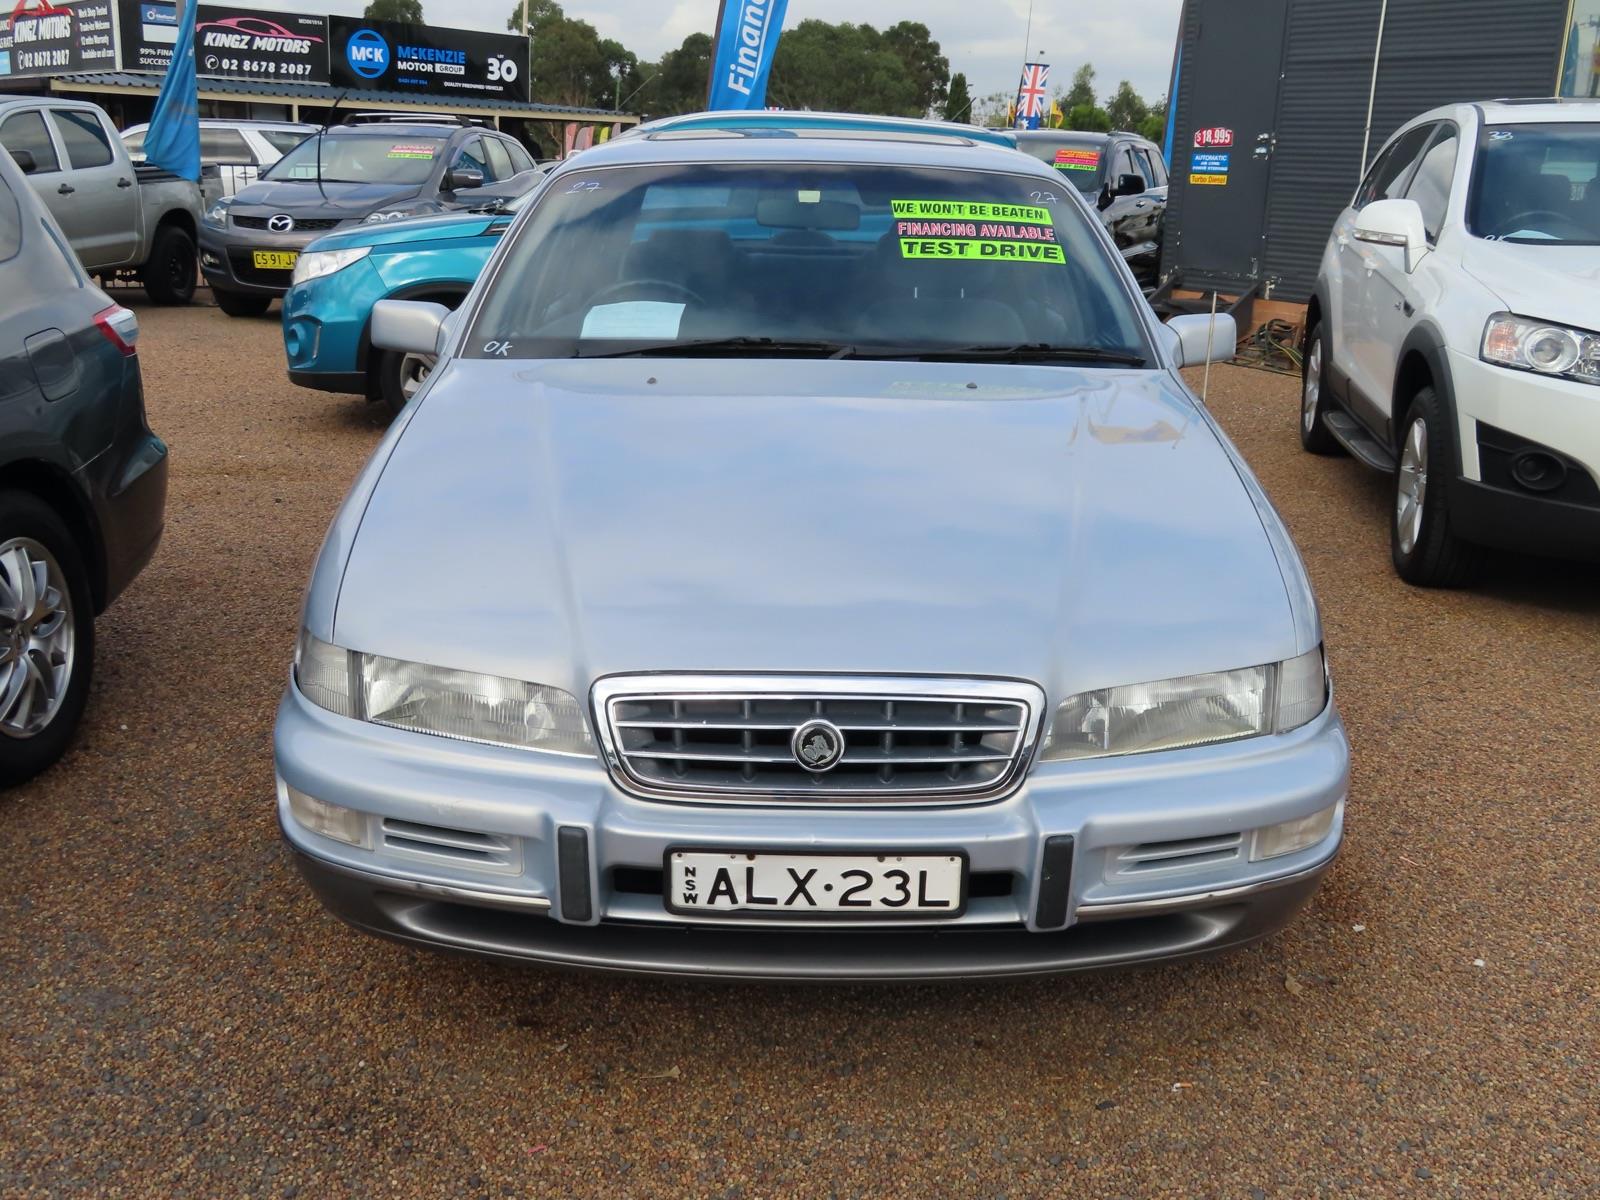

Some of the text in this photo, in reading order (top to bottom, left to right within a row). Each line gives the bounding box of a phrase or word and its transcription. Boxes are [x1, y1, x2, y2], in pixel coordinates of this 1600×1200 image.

[15, 19, 37, 43] KINGZ
[38, 15, 71, 40] MOTORS
[204, 32, 312, 54] KINGZ MOTORS
[24, 49, 70, 67] 02 8678 2087
[139, 48, 157, 56] 99%
[222, 58, 312, 75] 02 8678 2087
[397, 61, 463, 73] MOTOR GROUP
[486, 57, 518, 83] 30
[1196, 128, 1231, 145] $18,995
[565, 181, 603, 194] 27
[1030, 191, 1058, 204] 27
[893, 202, 1043, 219] WE WON'T BE BEATEN
[898, 222, 1054, 241] FINANCING AVAILABLE
[903, 241, 1059, 260] TEST DRIVE
[483, 340, 513, 357] OK
